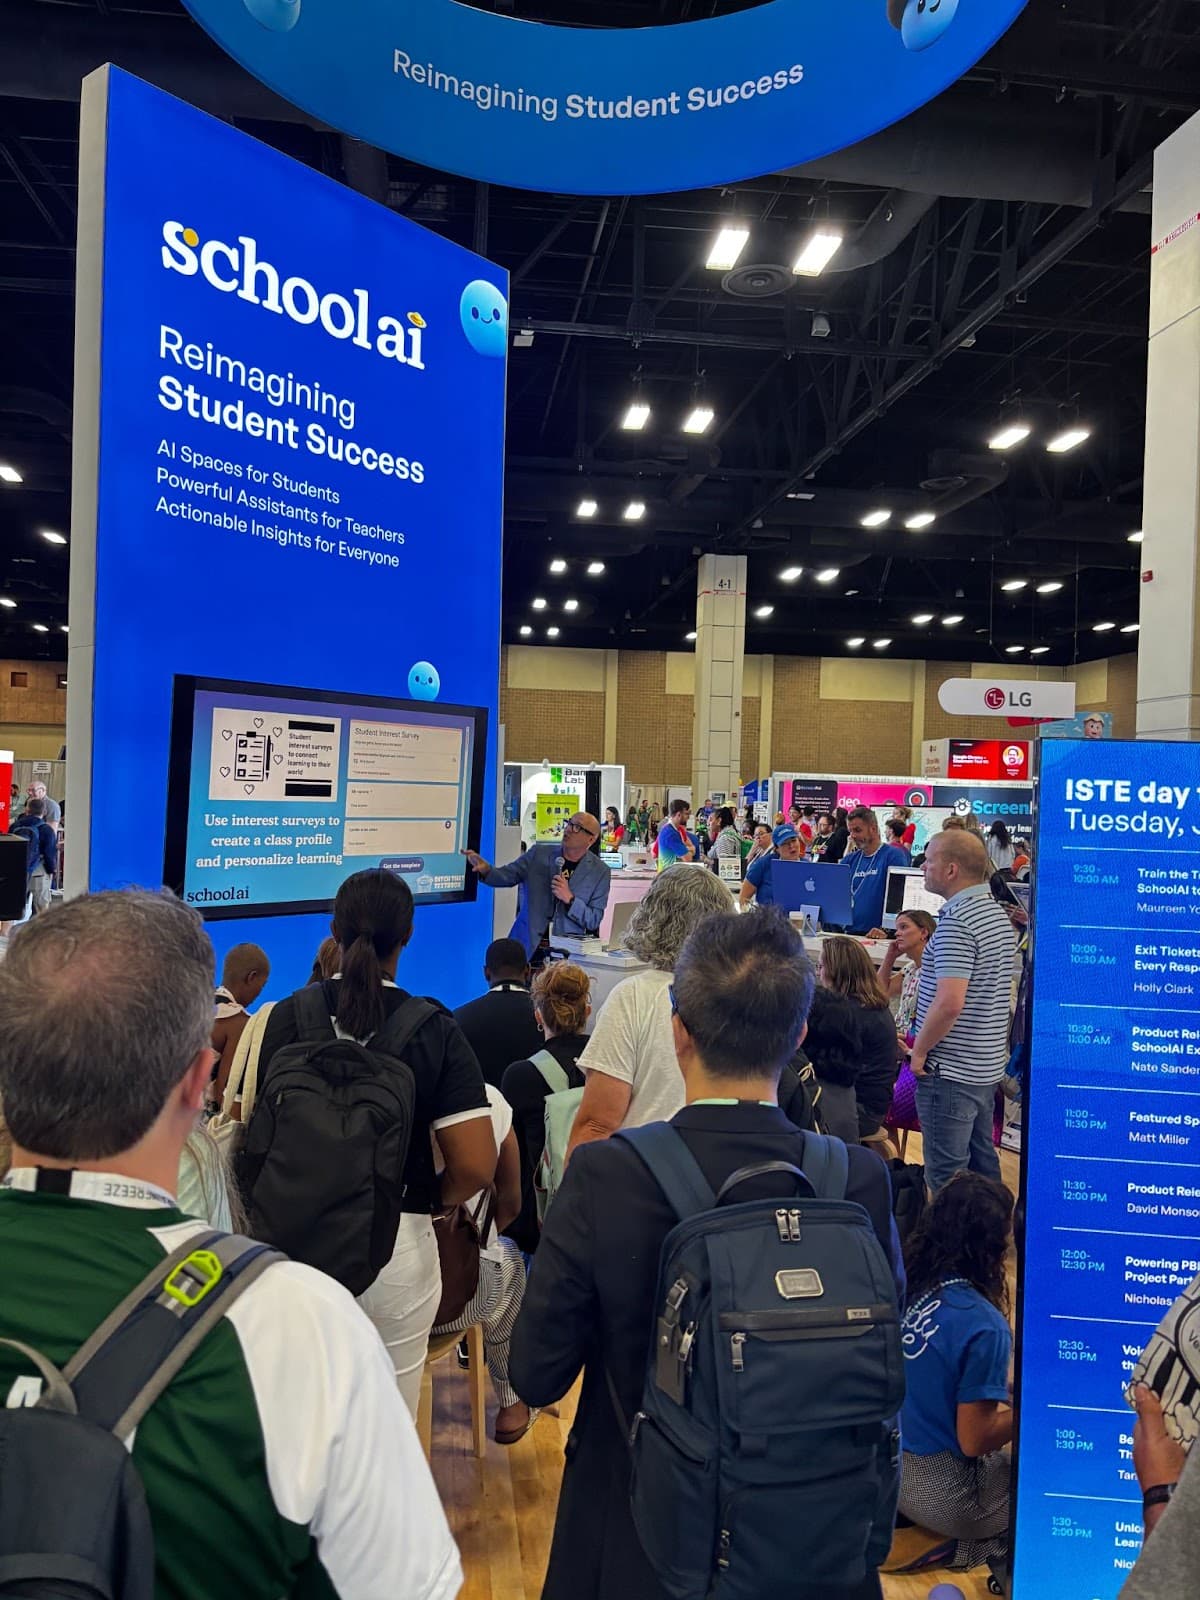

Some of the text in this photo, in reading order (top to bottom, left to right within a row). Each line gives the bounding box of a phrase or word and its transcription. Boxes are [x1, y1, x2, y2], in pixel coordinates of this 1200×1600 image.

[393, 48, 804, 121] Reimagining Student Success
[160, 324, 355, 430] Reimagining
[158, 374, 424, 484] Student Success
[157, 439, 340, 504] AI Spaces for Students
[157, 466, 405, 545] Powerful Assistants for Teachers
[155, 496, 400, 568] Actionable Insights for Everyone
[718, 579, 731, 589] 4-1
[1009, 691, 1032, 707] LG
[288, 733, 312, 741] Student
[288, 742, 333, 752] interest surveys
[1066, 778, 1131, 802] ISTE
[1137, 781, 1191, 809] day
[204, 814, 340, 828] Use interest surveys to
[1064, 807, 1184, 839] Tuesday,
[211, 833, 333, 848] create a class profile
[196, 852, 343, 869] and personalize learning
[1073, 864, 1096, 873] 9:30
[1137, 868, 1167, 879] Train
[1169, 870, 1189, 880] the
[1073, 875, 1119, 884] 10:00 AM
[1137, 883, 1189, 895] SchoolAI
[1136, 902, 1186, 914] Maureen
[1071, 944, 1097, 953] 10:00
[1135, 945, 1157, 956] Exit
[1070, 954, 1117, 965] 10:30 AM
[1134, 960, 1166, 973] Every
[1133, 982, 1194, 994] Holly Clark
[1067, 1024, 1093, 1033] 10:30
[1132, 1026, 1179, 1038] Product
[1067, 1035, 1111, 1045] 11:00 AM
[1131, 1042, 1184, 1054] SchoolAI
[1131, 1062, 1158, 1073] Nate
[1065, 1109, 1088, 1118] 11:00
[1129, 1111, 1182, 1124] Featured
[1064, 1119, 1107, 1130] 11:30 PM
[1129, 1131, 1190, 1145] Matt Miller
[1063, 1180, 1086, 1190] 11:30
[1127, 1183, 1175, 1195] Product
[1062, 1191, 1107, 1202] 12:00 PM
[1127, 1202, 1158, 1215] David
[1061, 1260, 1105, 1271] 12:30 PM
[1125, 1256, 1179, 1271] Powering
[1125, 1271, 1167, 1284] Project
[1124, 1293, 1172, 1306] Nicholas
[1058, 1340, 1084, 1350] 12:30
[1058, 1350, 1097, 1361] 1:00 PM
[1055, 1429, 1075, 1439] 1:00
[1055, 1440, 1094, 1451] 1:30 PM
[1052, 1516, 1071, 1527] 1:30
[1051, 1527, 1093, 1538] 2:00 PM
